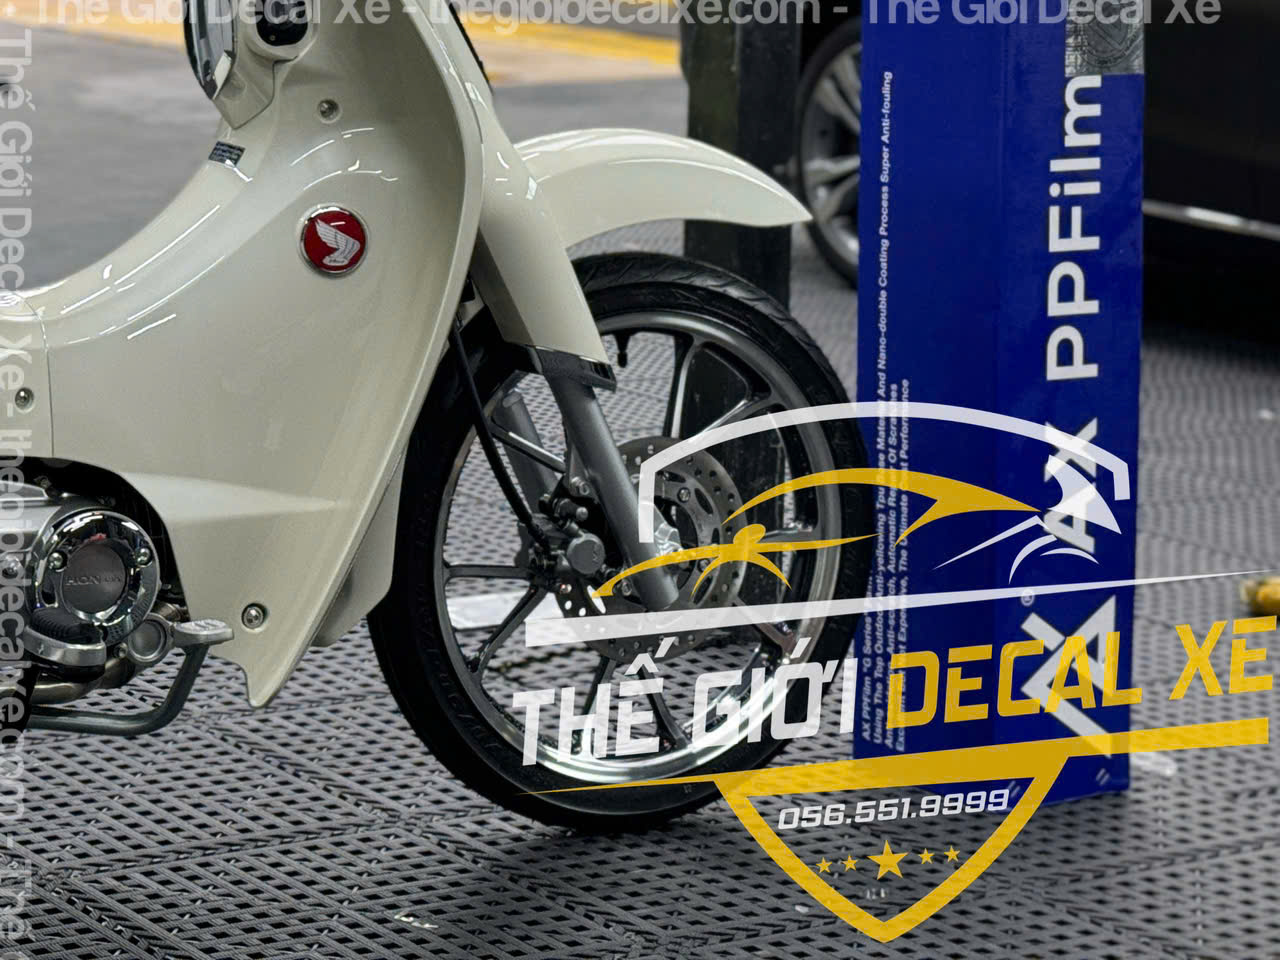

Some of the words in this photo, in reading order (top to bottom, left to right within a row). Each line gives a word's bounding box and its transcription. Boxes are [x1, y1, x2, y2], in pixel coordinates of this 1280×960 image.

[881, 71, 892, 144] Anti-fouling
[880, 146, 891, 183] Super
[878, 186, 889, 236] Process
[1046, 75, 1102, 381] PPFilm
[878, 239, 889, 287] Coating
[878, 290, 887, 369] Nano-double
[878, 372, 886, 397] And
[889, 384, 898, 446] Scrahes
[900, 379, 910, 460] Perfornce
[889, 448, 897, 463] Of
[889, 466, 897, 507] Repr
[888, 510, 897, 574] Automatic
[899, 550, 908, 572] The
[887, 576, 896, 655] Anti-scch,
[899, 576, 908, 641] Expeive,
[874, 656, 884, 678] Top
[862, 676, 871, 720] PPFilm
[874, 682, 882, 704] The
[862, 722, 871, 740] AX
[874, 708, 883, 744] Using
